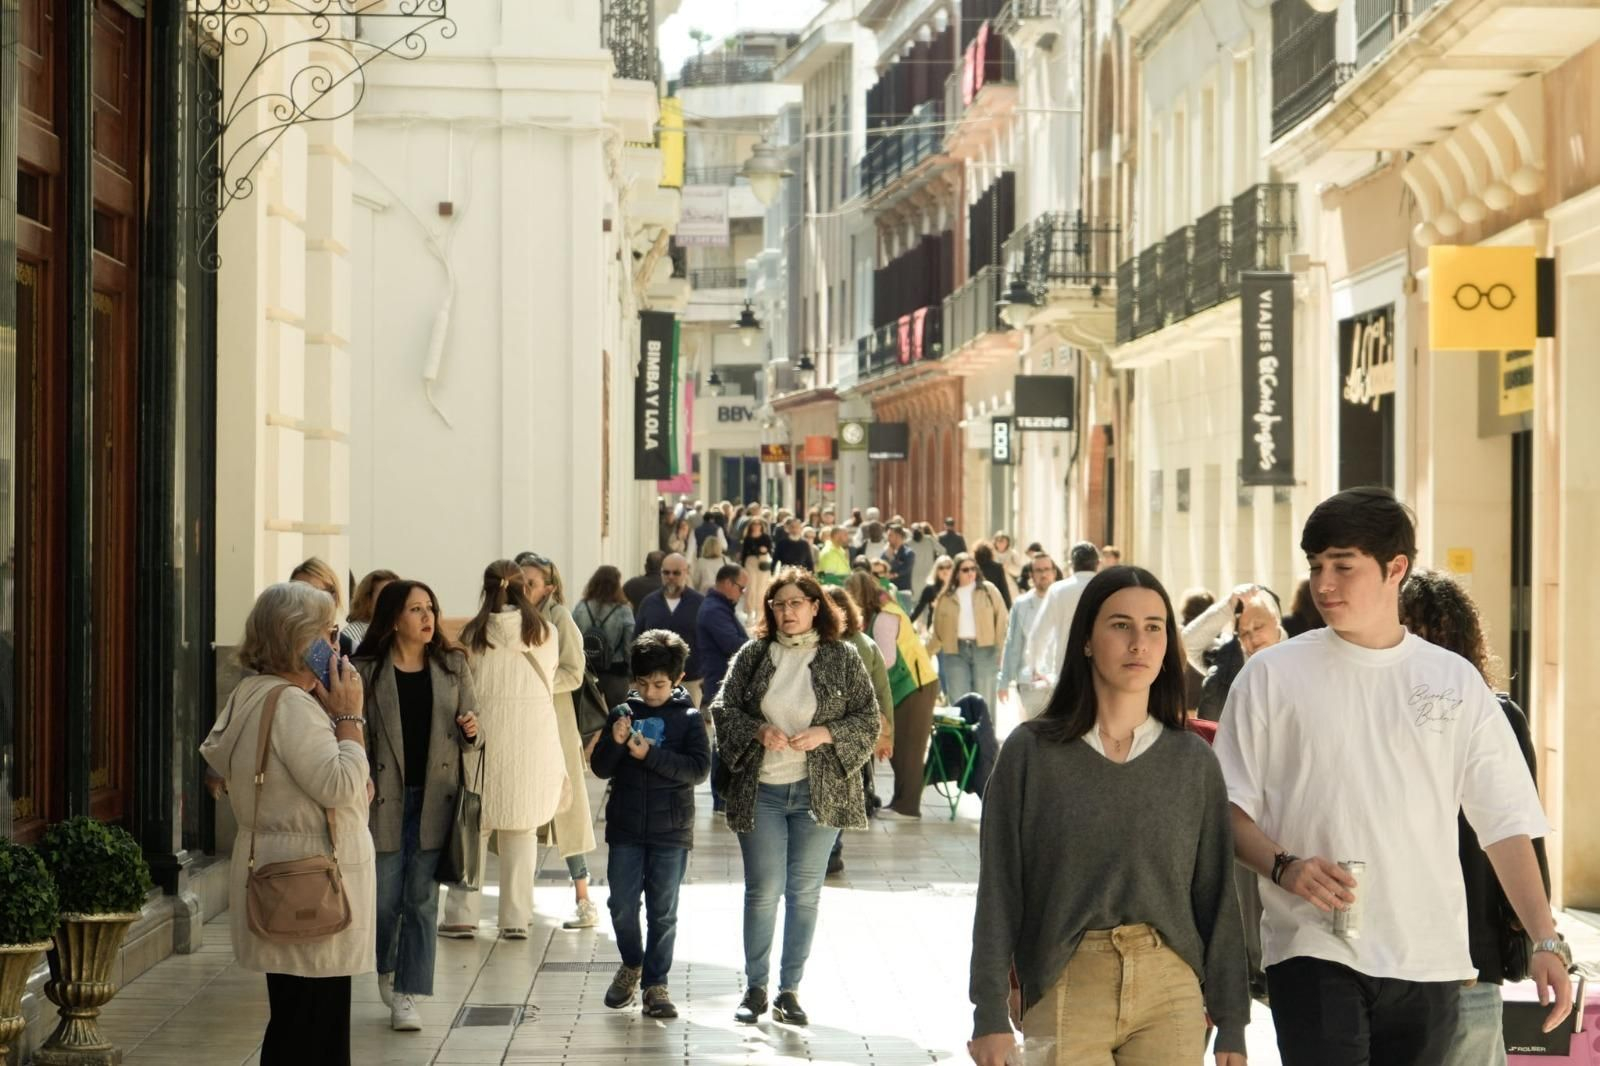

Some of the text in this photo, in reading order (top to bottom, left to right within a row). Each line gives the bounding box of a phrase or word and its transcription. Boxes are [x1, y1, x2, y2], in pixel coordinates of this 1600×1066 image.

[1257, 290, 1273, 352] VIAJES
[644, 340, 661, 450] BIMBA Y LOLA
